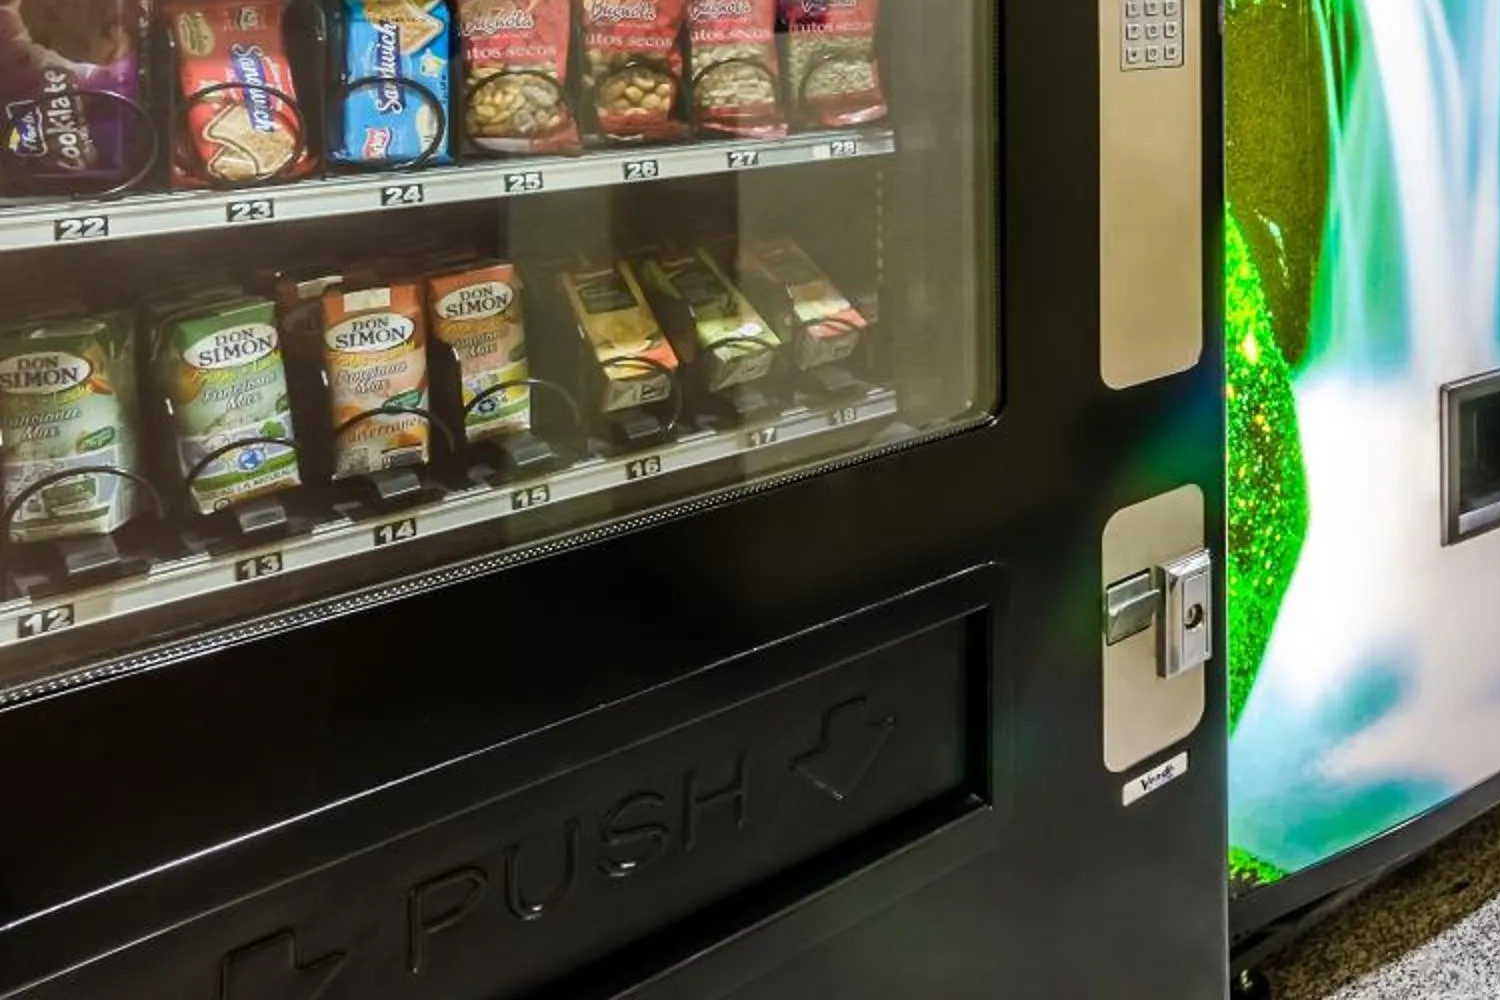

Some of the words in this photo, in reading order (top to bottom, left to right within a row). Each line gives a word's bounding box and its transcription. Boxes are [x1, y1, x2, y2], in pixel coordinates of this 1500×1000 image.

[379, 22, 402, 115] Sandwich
[231, 43, 276, 134] Sandwich
[832, 143, 854, 155] 28
[730, 153, 756, 166] 27
[627, 162, 656, 178] 26
[507, 174, 541, 191] 25
[385, 186, 420, 204] 24
[230, 203, 271, 220] 23
[60, 219, 105, 239] 22
[460, 286, 494, 300] DON
[445, 294, 507, 318] SIMON
[352, 316, 389, 331] DON
[215, 328, 254, 346] DON
[335, 325, 406, 349] SIMON
[199, 335, 274, 366] SIMON
[18, 356, 58, 369] DON
[1, 368, 78, 388] SIMON
[833, 408, 854, 424] 18
[753, 428, 774, 446] 17
[630, 459, 659, 477] 16
[515, 487, 548, 507] 15
[379, 521, 414, 542] 14
[242, 557, 279, 578] 13
[23, 607, 71, 633] 12
[407, 751, 748, 975] PUSH
